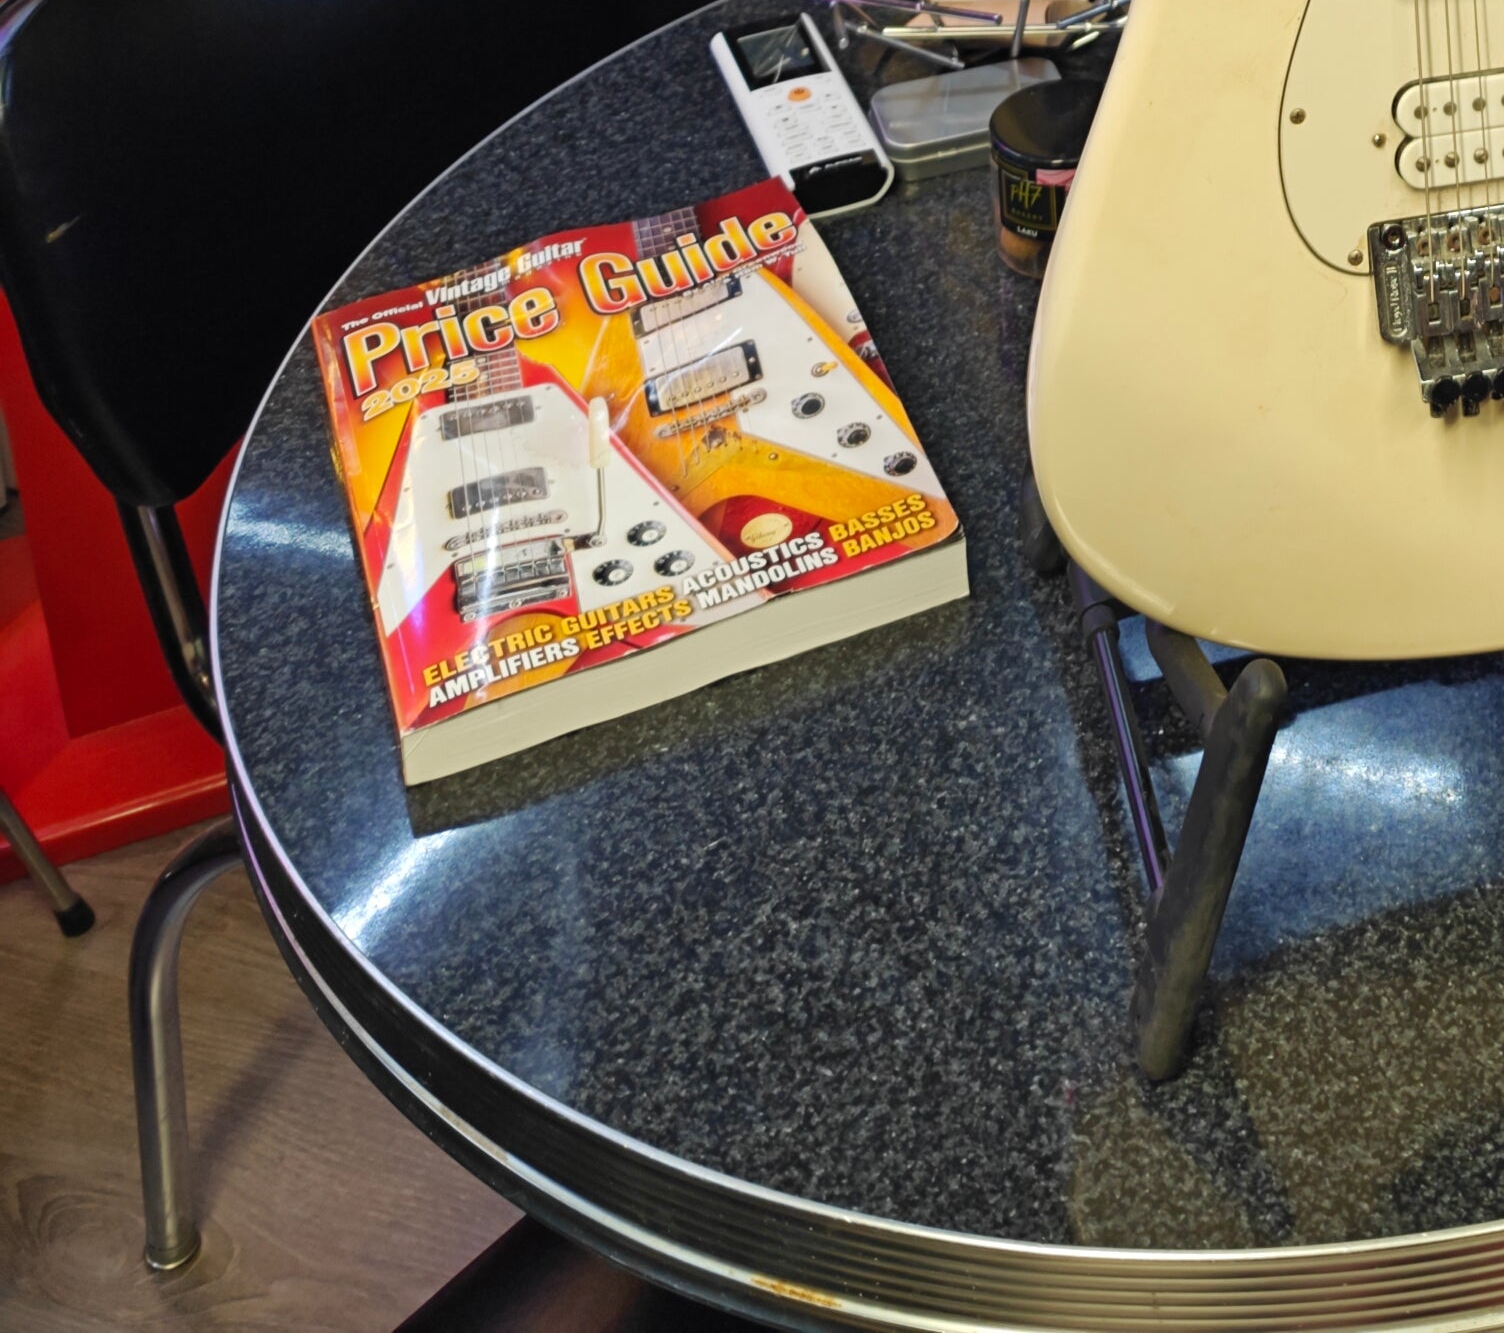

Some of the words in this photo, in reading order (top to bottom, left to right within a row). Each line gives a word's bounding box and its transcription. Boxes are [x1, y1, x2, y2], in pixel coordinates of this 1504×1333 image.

[341, 315, 369, 332] The
[371, 301, 424, 321] Official
[425, 264, 511, 307] Vintage
[516, 238, 585, 274] Guitar
[342, 287, 560, 399] Price
[578, 211, 798, 315] Guide
[361, 356, 481, 422] 2025
[422, 624, 554, 687] ELECTRIC
[560, 585, 676, 635] GUITARS
[682, 532, 825, 596] ACOUSTICS
[828, 493, 927, 541] BASSES
[427, 638, 581, 708] AMPLIFIERS
[587, 600, 692, 651] EFFECTS
[698, 547, 839, 611] MANDOLINS
[844, 510, 936, 558] BANJOS
